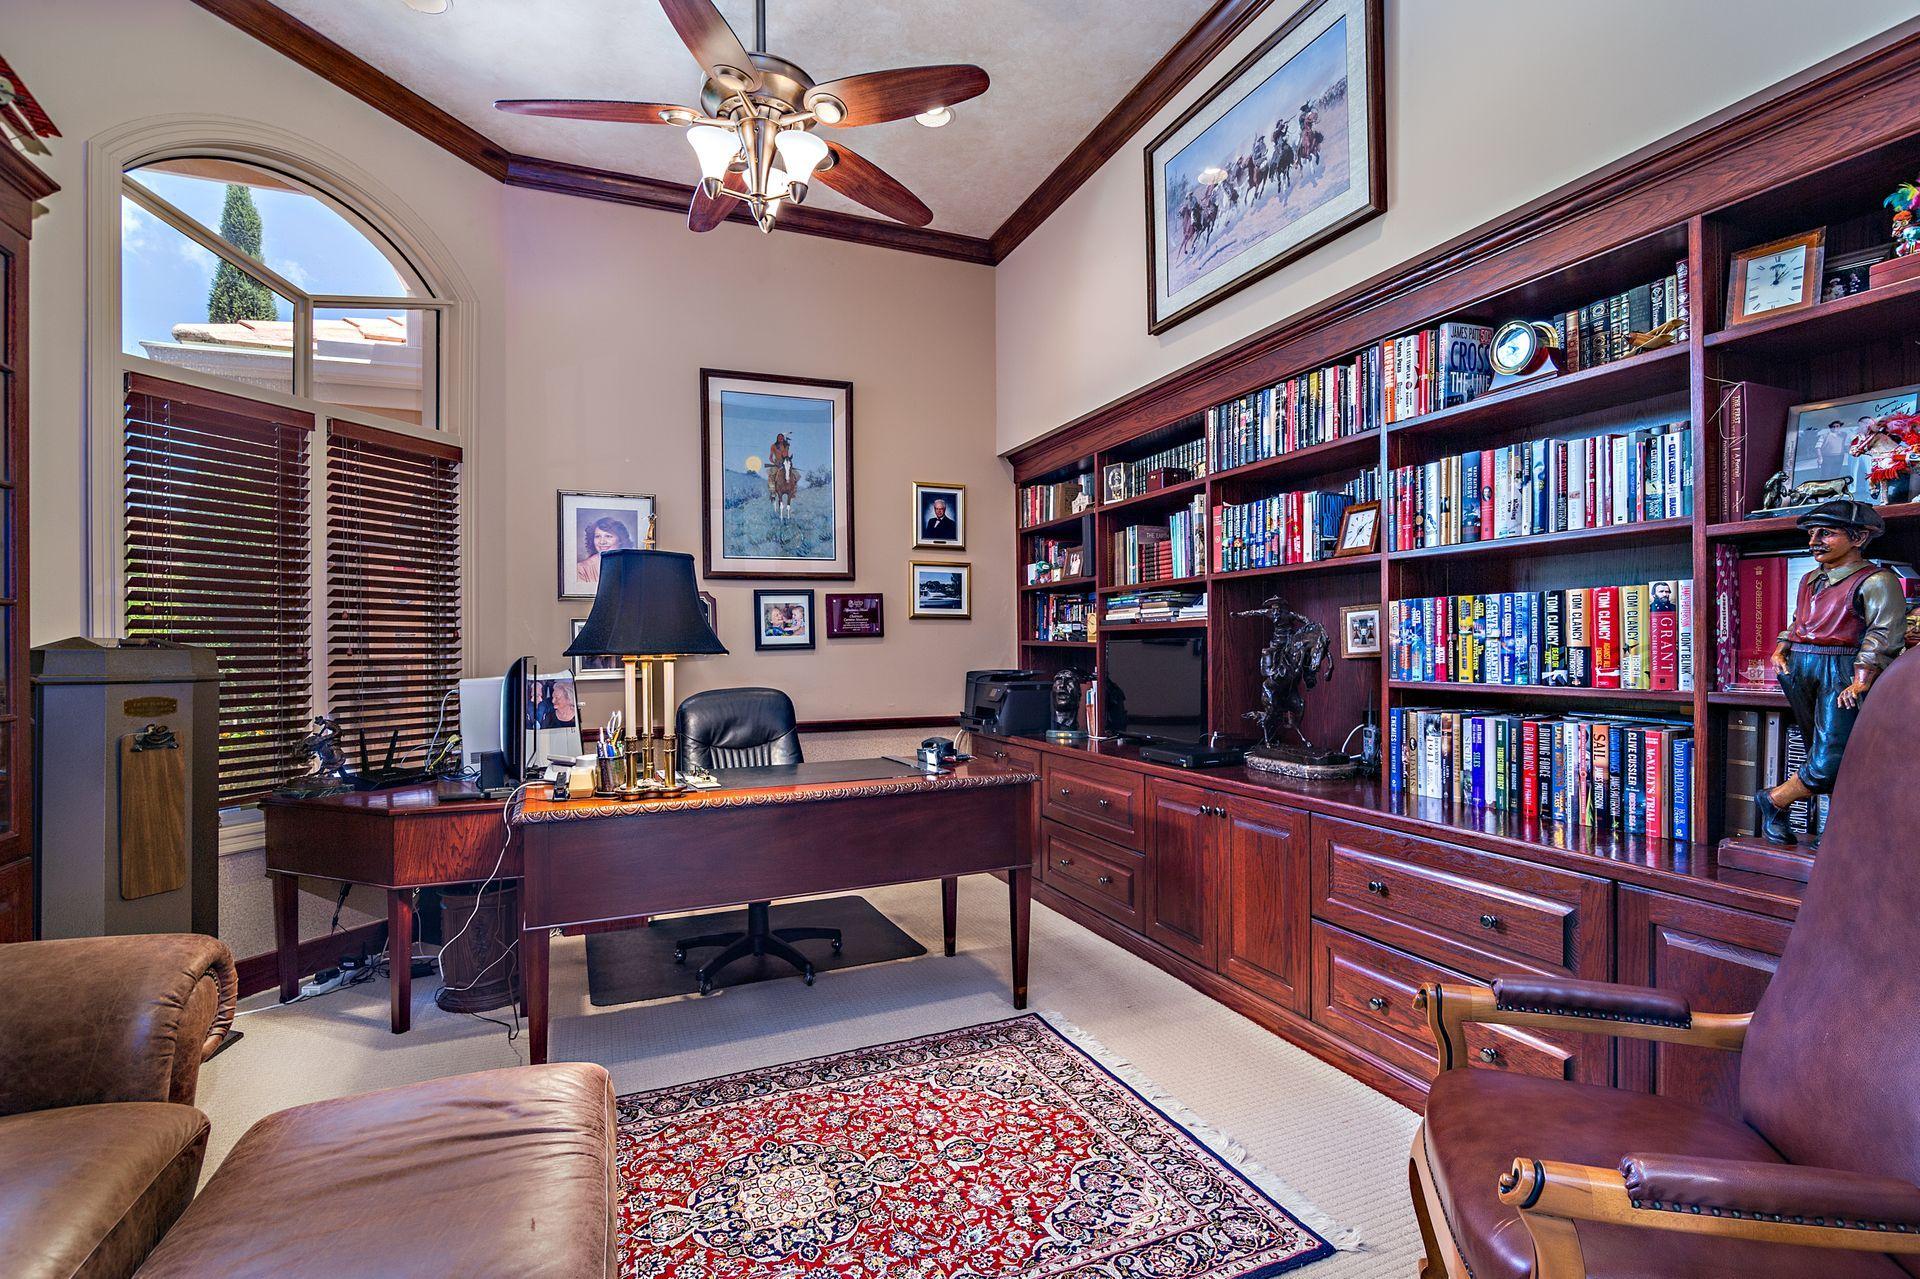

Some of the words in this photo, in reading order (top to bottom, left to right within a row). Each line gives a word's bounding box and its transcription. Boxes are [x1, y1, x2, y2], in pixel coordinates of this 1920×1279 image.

[1451, 326, 1468, 338] JAMES
[1384, 346, 1394, 388] AIRFRAME
[1451, 372, 1469, 394] THE
[1515, 595, 1523, 612] CLIVE
[1547, 595, 1558, 613] TOM
[1572, 593, 1582, 609] TOM
[1598, 591, 1611, 608] TOM
[1627, 591, 1638, 608] TOM
[1754, 580, 1763, 610] REFERENCE
[1515, 613, 1523, 638] CUSSLER
[1547, 615, 1558, 646] CLANCY
[1572, 610, 1582, 641] CLANCY
[1598, 610, 1611, 640] CLANCY
[1627, 610, 1638, 641] CLANCY
[1660, 617, 1674, 672] GRANT
[1681, 632, 1691, 654] DON'T
[1569, 648, 1577, 678] AUTHORITY
[1681, 654, 1691, 675] BLINK
[1523, 727, 1534, 742] DICK
[1539, 728, 1550, 756] DRIVING
[1593, 733, 1606, 761] SAIL
[1628, 732, 1637, 753] CLIVE
[1788, 733, 1808, 761] SOUTH
[1523, 743, 1534, 771] FRANCIS
[1539, 757, 1550, 777] FORCE
[1674, 743, 1685, 766] DAVID
[1595, 767, 1604, 782] JAMES
[1609, 775, 1619, 790] JAMES
[1628, 753, 1637, 786] CUSSLER
[1646, 747, 1656, 795] McNALLY'S
[1595, 782, 1604, 809] PATTERSON
[1674, 768, 1685, 804] BALDACCI
[1609, 790, 1619, 817] PATTERSON
[1646, 796, 1656, 823] TRIAL
[1789, 801, 1808, 827] HOME
